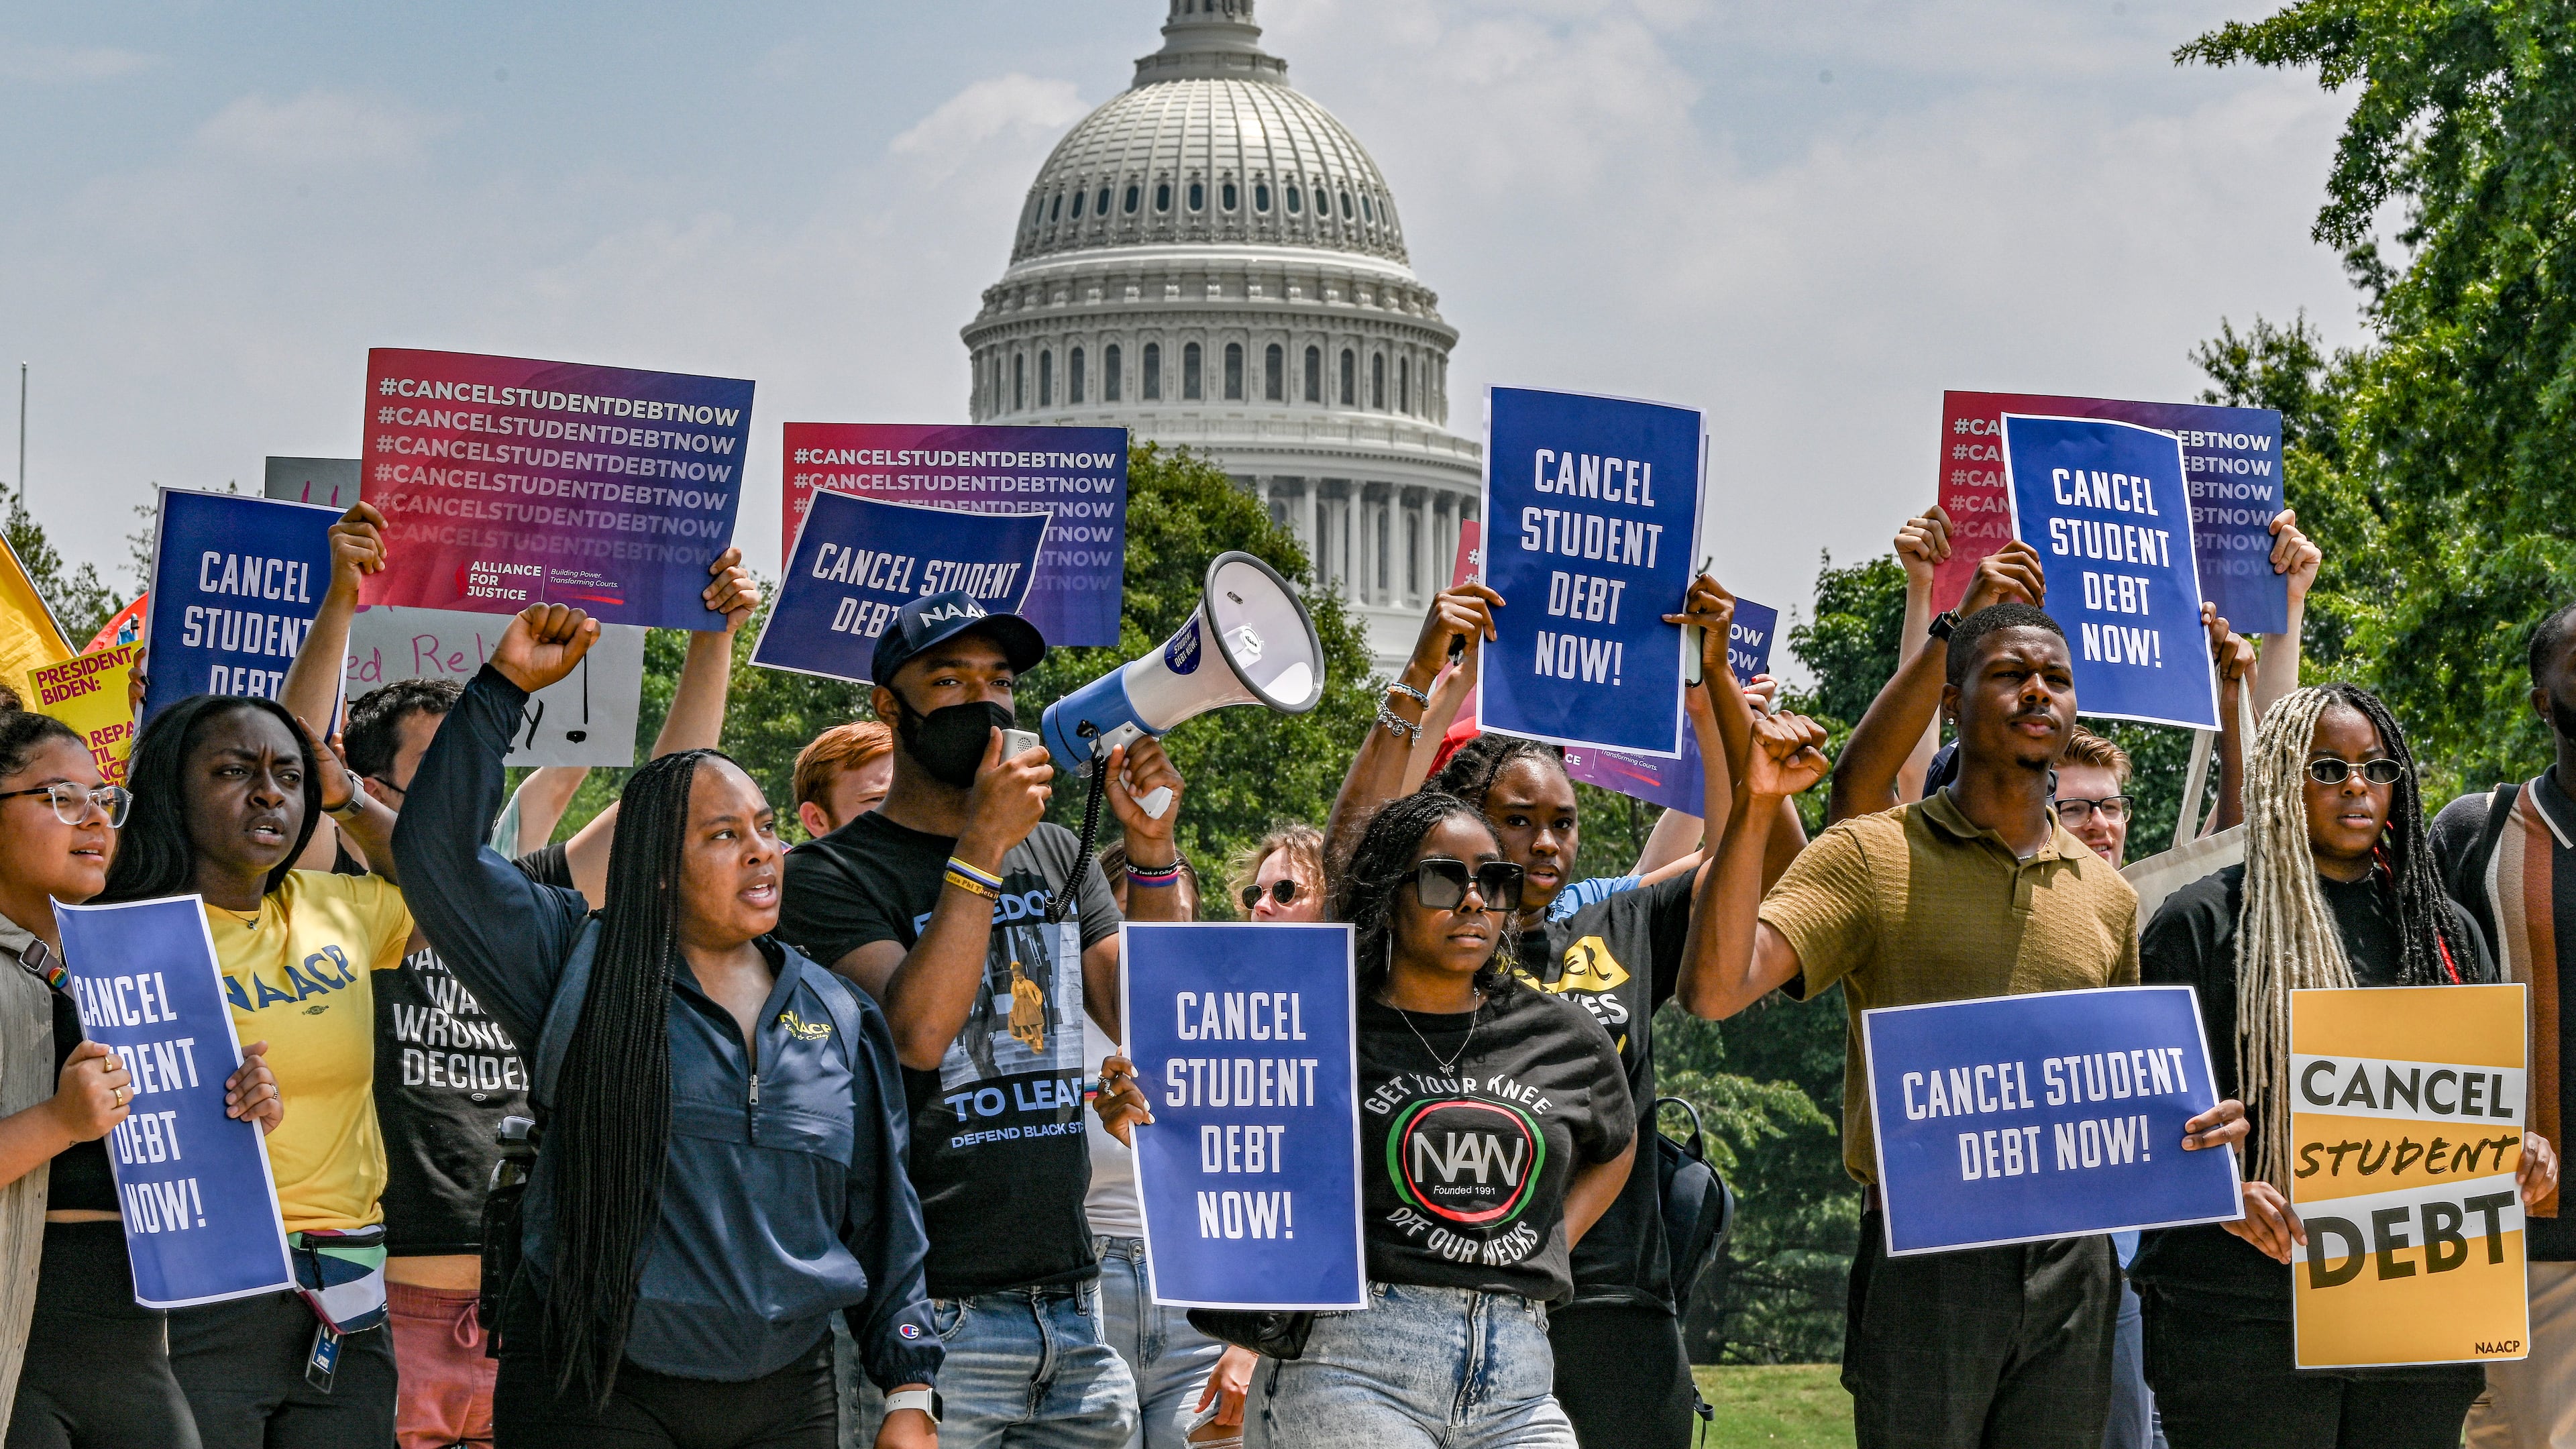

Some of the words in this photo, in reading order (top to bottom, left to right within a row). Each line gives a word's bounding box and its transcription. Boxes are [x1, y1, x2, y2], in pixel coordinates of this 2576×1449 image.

[379, 378, 739, 427] #CANCELSTUDENTDEBTNOW
[377, 406, 735, 455] #CANCELSTUDENTDEBTNOW
[376, 434, 732, 483] #CANCELSTUDENTDEBTNOW
[794, 448, 1116, 468] #CANCELSTUDENTDEBTNOW
[1534, 448, 1654, 507] CANCEL
[374, 463, 728, 511] #CANCELSTUDENTDEBTNOW
[794, 473, 1115, 494] #CANCELSTUDENTDEBTNOW
[2051, 468, 2159, 517] CANCEL
[374, 492, 723, 539] #CANCELSTUDENTDEBTNOW
[1521, 506, 1664, 569] STUDENT
[385, 521, 710, 565] CANCELSTUDENTDEBTNOW
[2048, 517, 2170, 568] STUDENT
[199, 551, 311, 604] CANCEL
[470, 561, 542, 577] ALLIANCE
[470, 573, 499, 586] FOR
[550, 576, 595, 588] Transforming
[596, 580, 619, 588] Courts.
[551, 568, 578, 578] Building
[580, 570, 602, 579] Power.
[812, 542, 916, 594] CANCEL
[919, 559, 1022, 599] STUDENT
[467, 586, 527, 601] JUSTICE
[919, 602, 989, 629] NAA
[1548, 570, 1626, 625] DEBT
[2082, 571, 2150, 616] DEBT
[36, 646, 132, 688] PRESIDENT
[412, 633, 496, 675] Rel
[1534, 630, 1623, 687] NOW!
[2081, 622, 2163, 669] NOW!
[40, 676, 102, 706] BIDEN:
[1601, 749, 1638, 766] Transforming
[947, 873, 961, 883] Iota
[961, 879, 974, 890] Phi
[74, 971, 178, 1028] CANCEL
[222, 945, 358, 1012] NAACP
[780, 1010, 832, 1034] NAACP
[1176, 991, 1307, 1040] CANCEL
[403, 1048, 529, 1092] DECIDE
[1165, 1058, 1319, 1107] STUDENT
[1902, 1061, 2035, 1121] CANCEL
[2042, 1047, 2188, 1106] STUDENT
[2300, 1060, 2514, 1118] CANCEL
[944, 1087, 1006, 1123] TO
[1364, 1075, 1412, 1116] GET
[1409, 1073, 1477, 1094] YOUR
[1487, 1074, 1554, 1116] KNEE
[115, 1110, 182, 1165] DEBT
[951, 1127, 1020, 1148] DEFEND
[1023, 1122, 1067, 1138] BLACK
[1201, 1125, 1285, 1173] DEBT
[1958, 1125, 2041, 1181] DEBT
[2053, 1114, 2151, 1172] NOW!
[2294, 1134, 2520, 1179] STUDENT
[1413, 1132, 1524, 1187] NAN
[125, 1177, 207, 1234] NOW!
[1433, 1185, 1472, 1195] Founded
[1474, 1186, 1496, 1195] 1991
[1197, 1191, 1294, 1240] NOW!
[1386, 1207, 1434, 1237] OFF
[1427, 1227, 1479, 1263] OUR
[1483, 1221, 1539, 1267] NECKS
[2302, 1190, 2516, 1289] DEBT
[2475, 1340, 2520, 1354] NAACP
